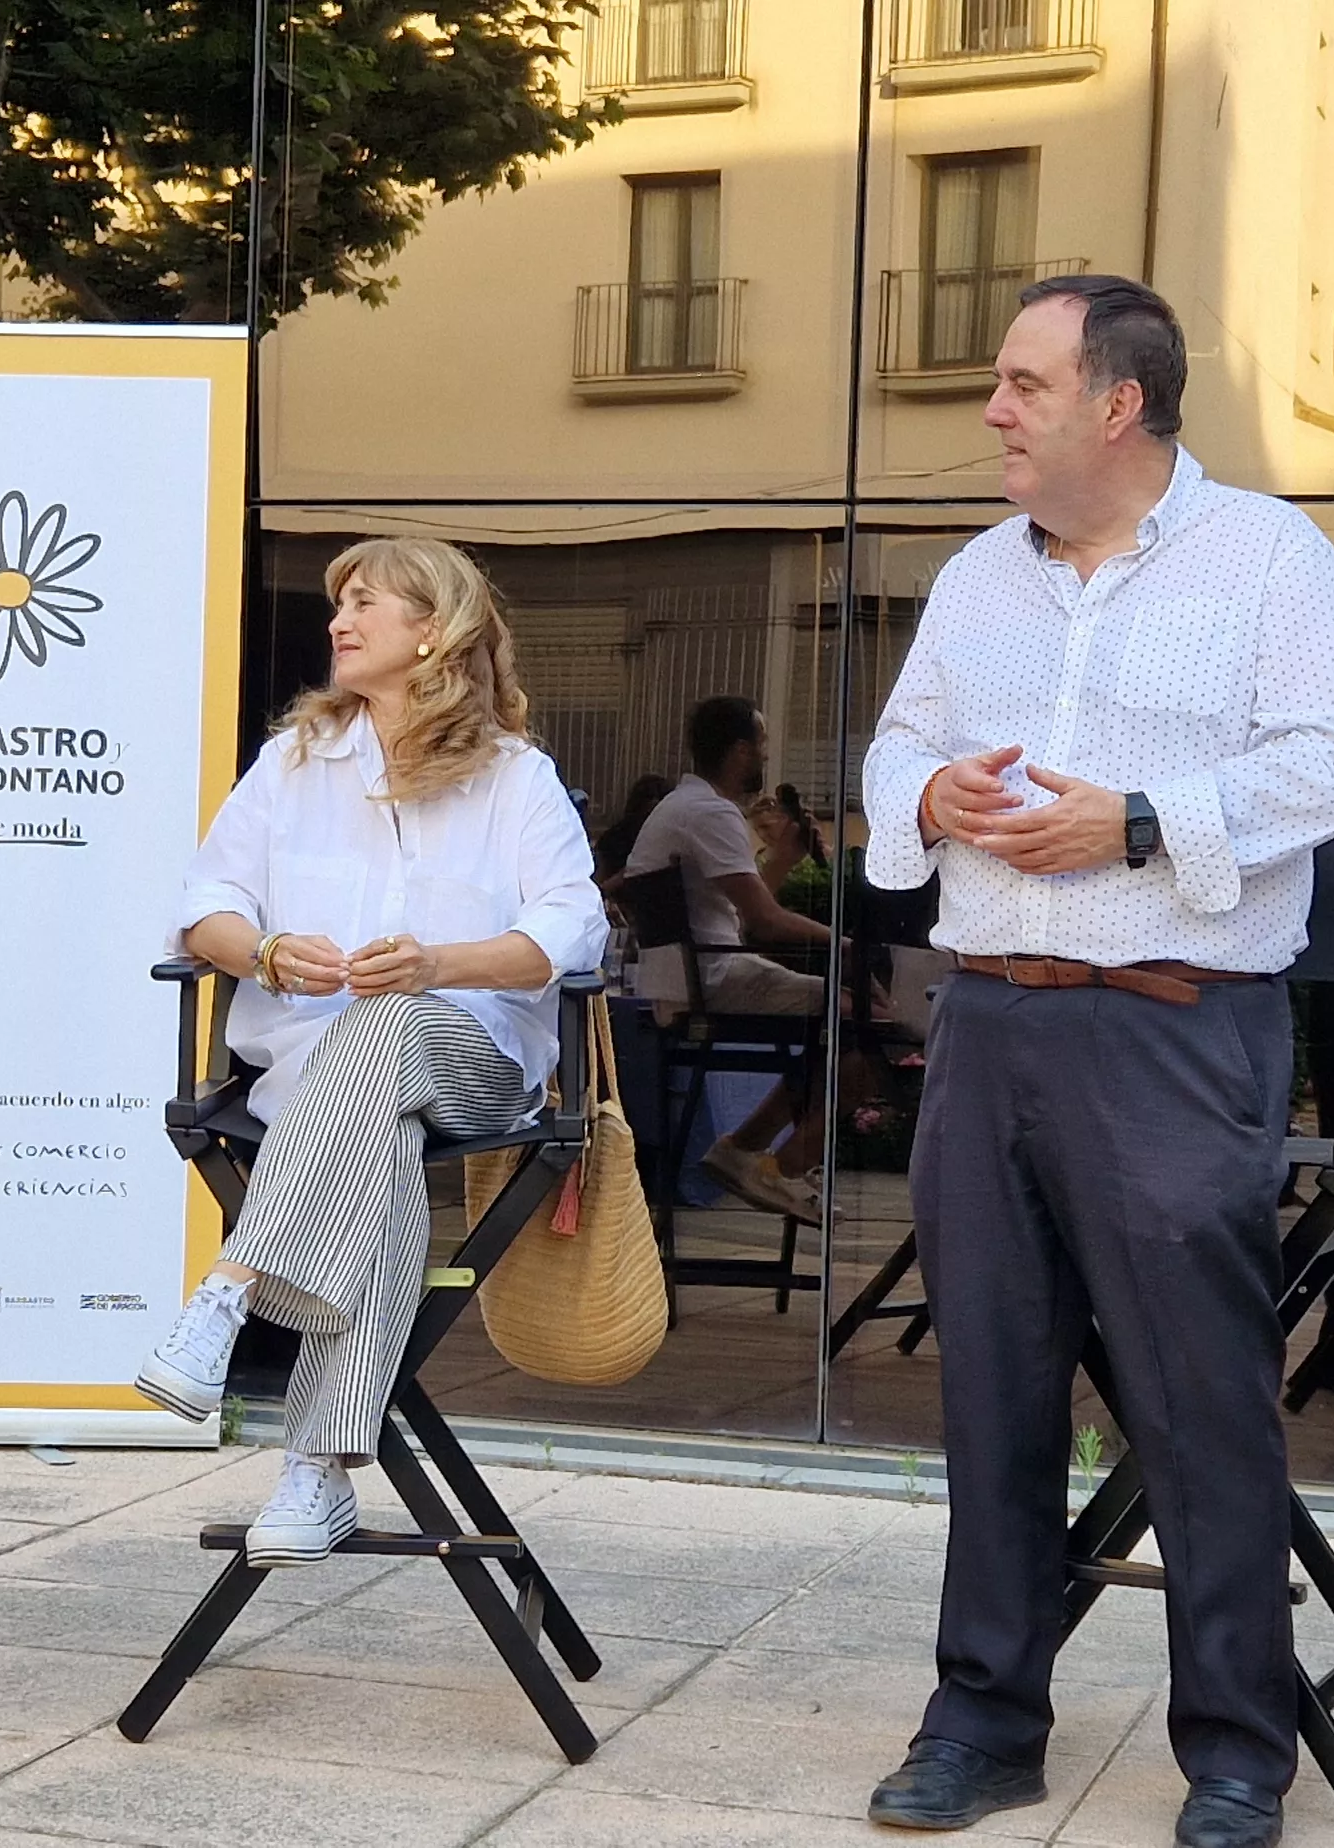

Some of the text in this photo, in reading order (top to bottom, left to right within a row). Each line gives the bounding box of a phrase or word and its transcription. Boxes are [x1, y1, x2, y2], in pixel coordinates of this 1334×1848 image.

[108, 742, 130, 764] y
[12, 817, 83, 840] moda
[78, 1095, 100, 1109] en
[105, 1091, 150, 1114] algo:
[12, 1141, 127, 1160] COMERCIO
